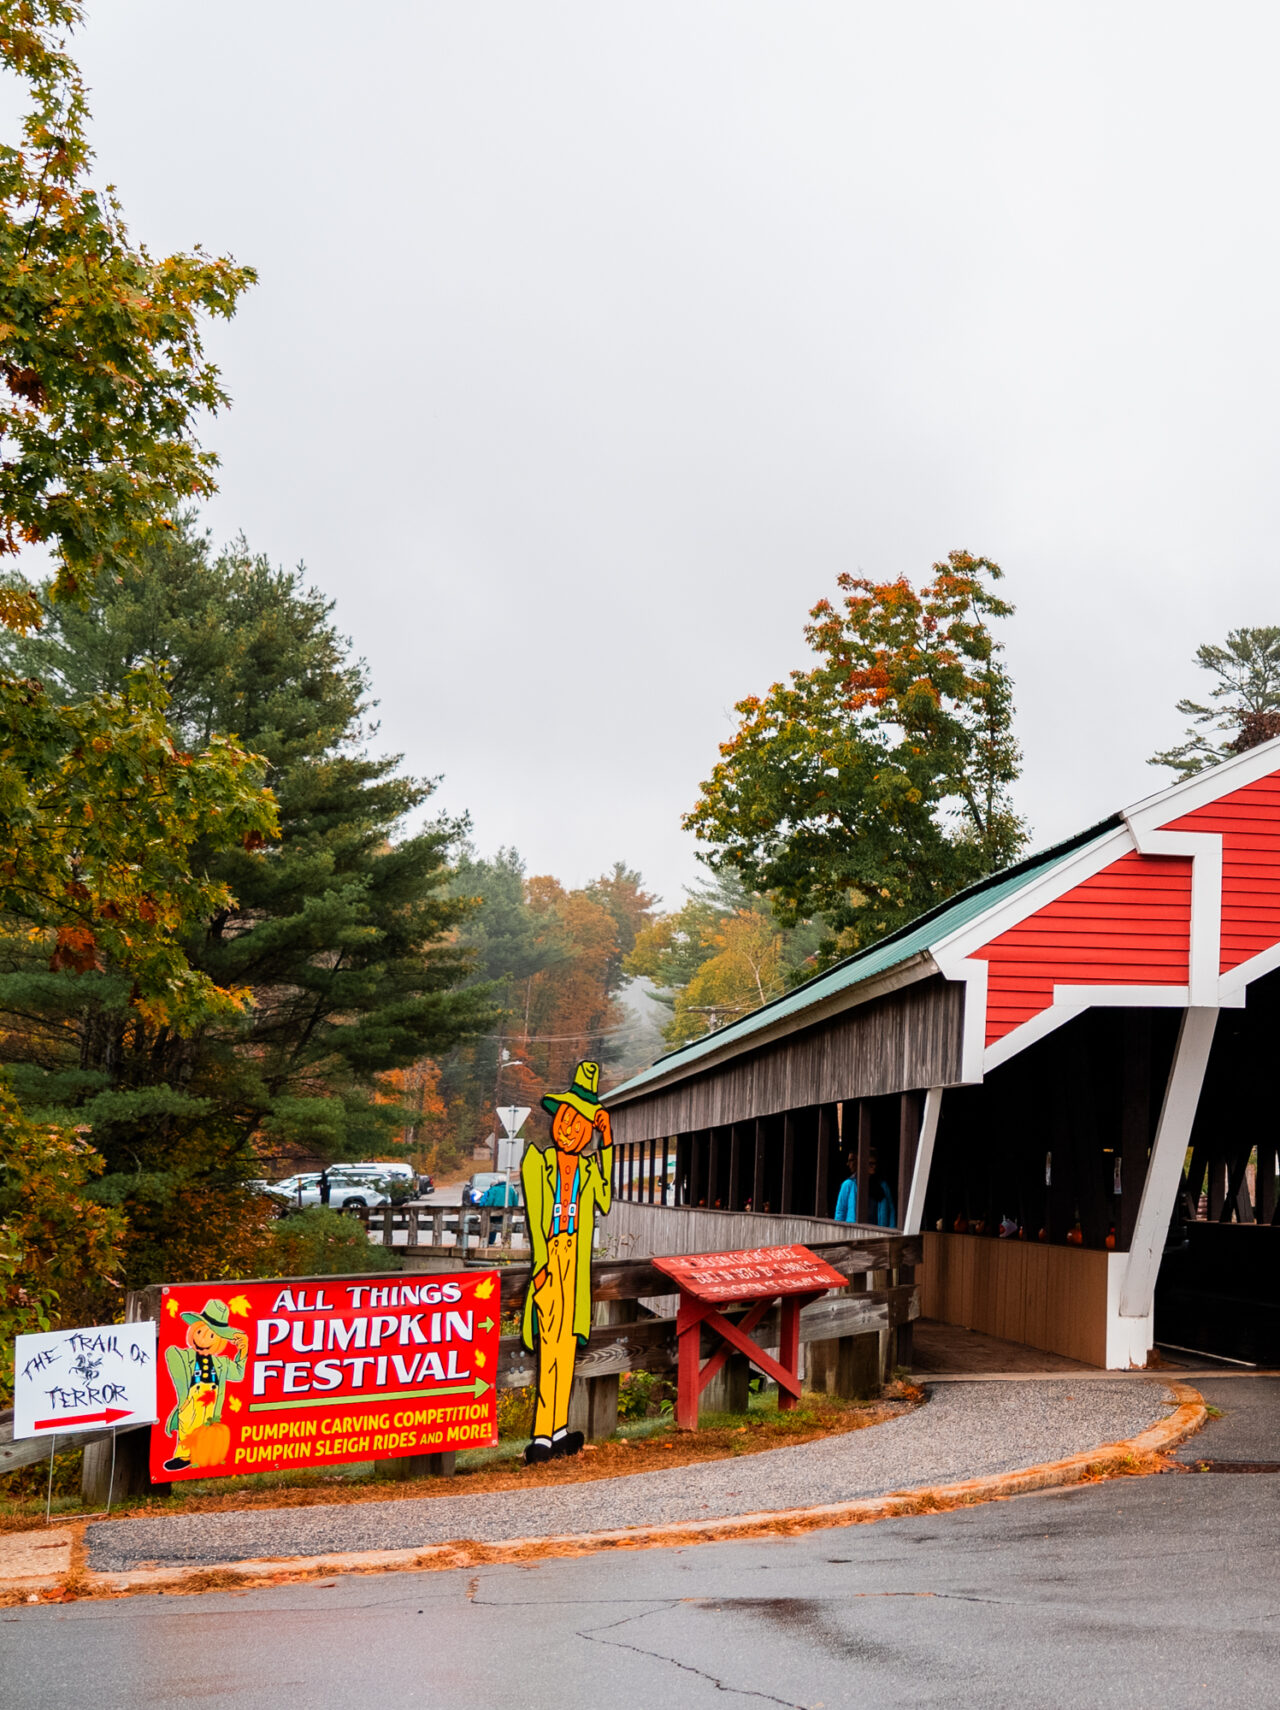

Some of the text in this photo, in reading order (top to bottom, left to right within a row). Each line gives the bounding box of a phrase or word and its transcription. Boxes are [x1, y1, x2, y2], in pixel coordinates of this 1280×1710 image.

[272, 1282, 462, 1313] ALL THINGS
[255, 1310, 474, 1355] PUMPKIN
[21, 1332, 150, 1382] THE TRAIL OF
[252, 1350, 471, 1396] FESTIVAL
[43, 1382, 129, 1410] TERROR
[234, 1422, 492, 1465] PUMPKIN SLEIGH RIDES AND MORE!
[240, 1403, 489, 1442] PUMPKIN CARVING COMPETITION
